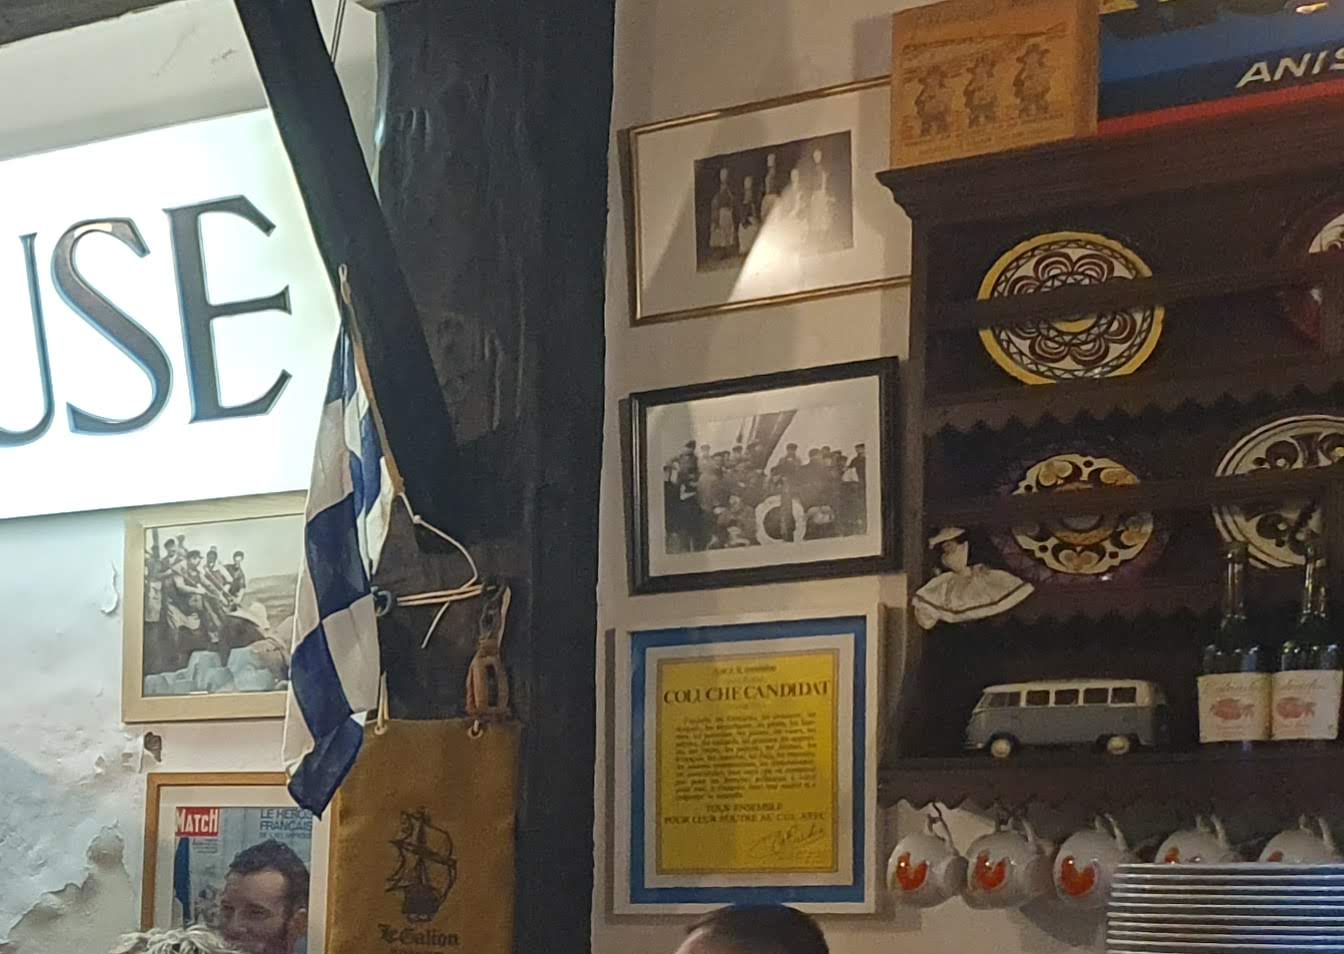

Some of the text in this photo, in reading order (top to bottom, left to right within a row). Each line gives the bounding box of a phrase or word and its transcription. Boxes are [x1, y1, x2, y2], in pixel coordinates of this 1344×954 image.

[743, 680, 831, 700] CANDIDAT
[176, 807, 218, 833] MATCH
[260, 808, 274, 819] LE
